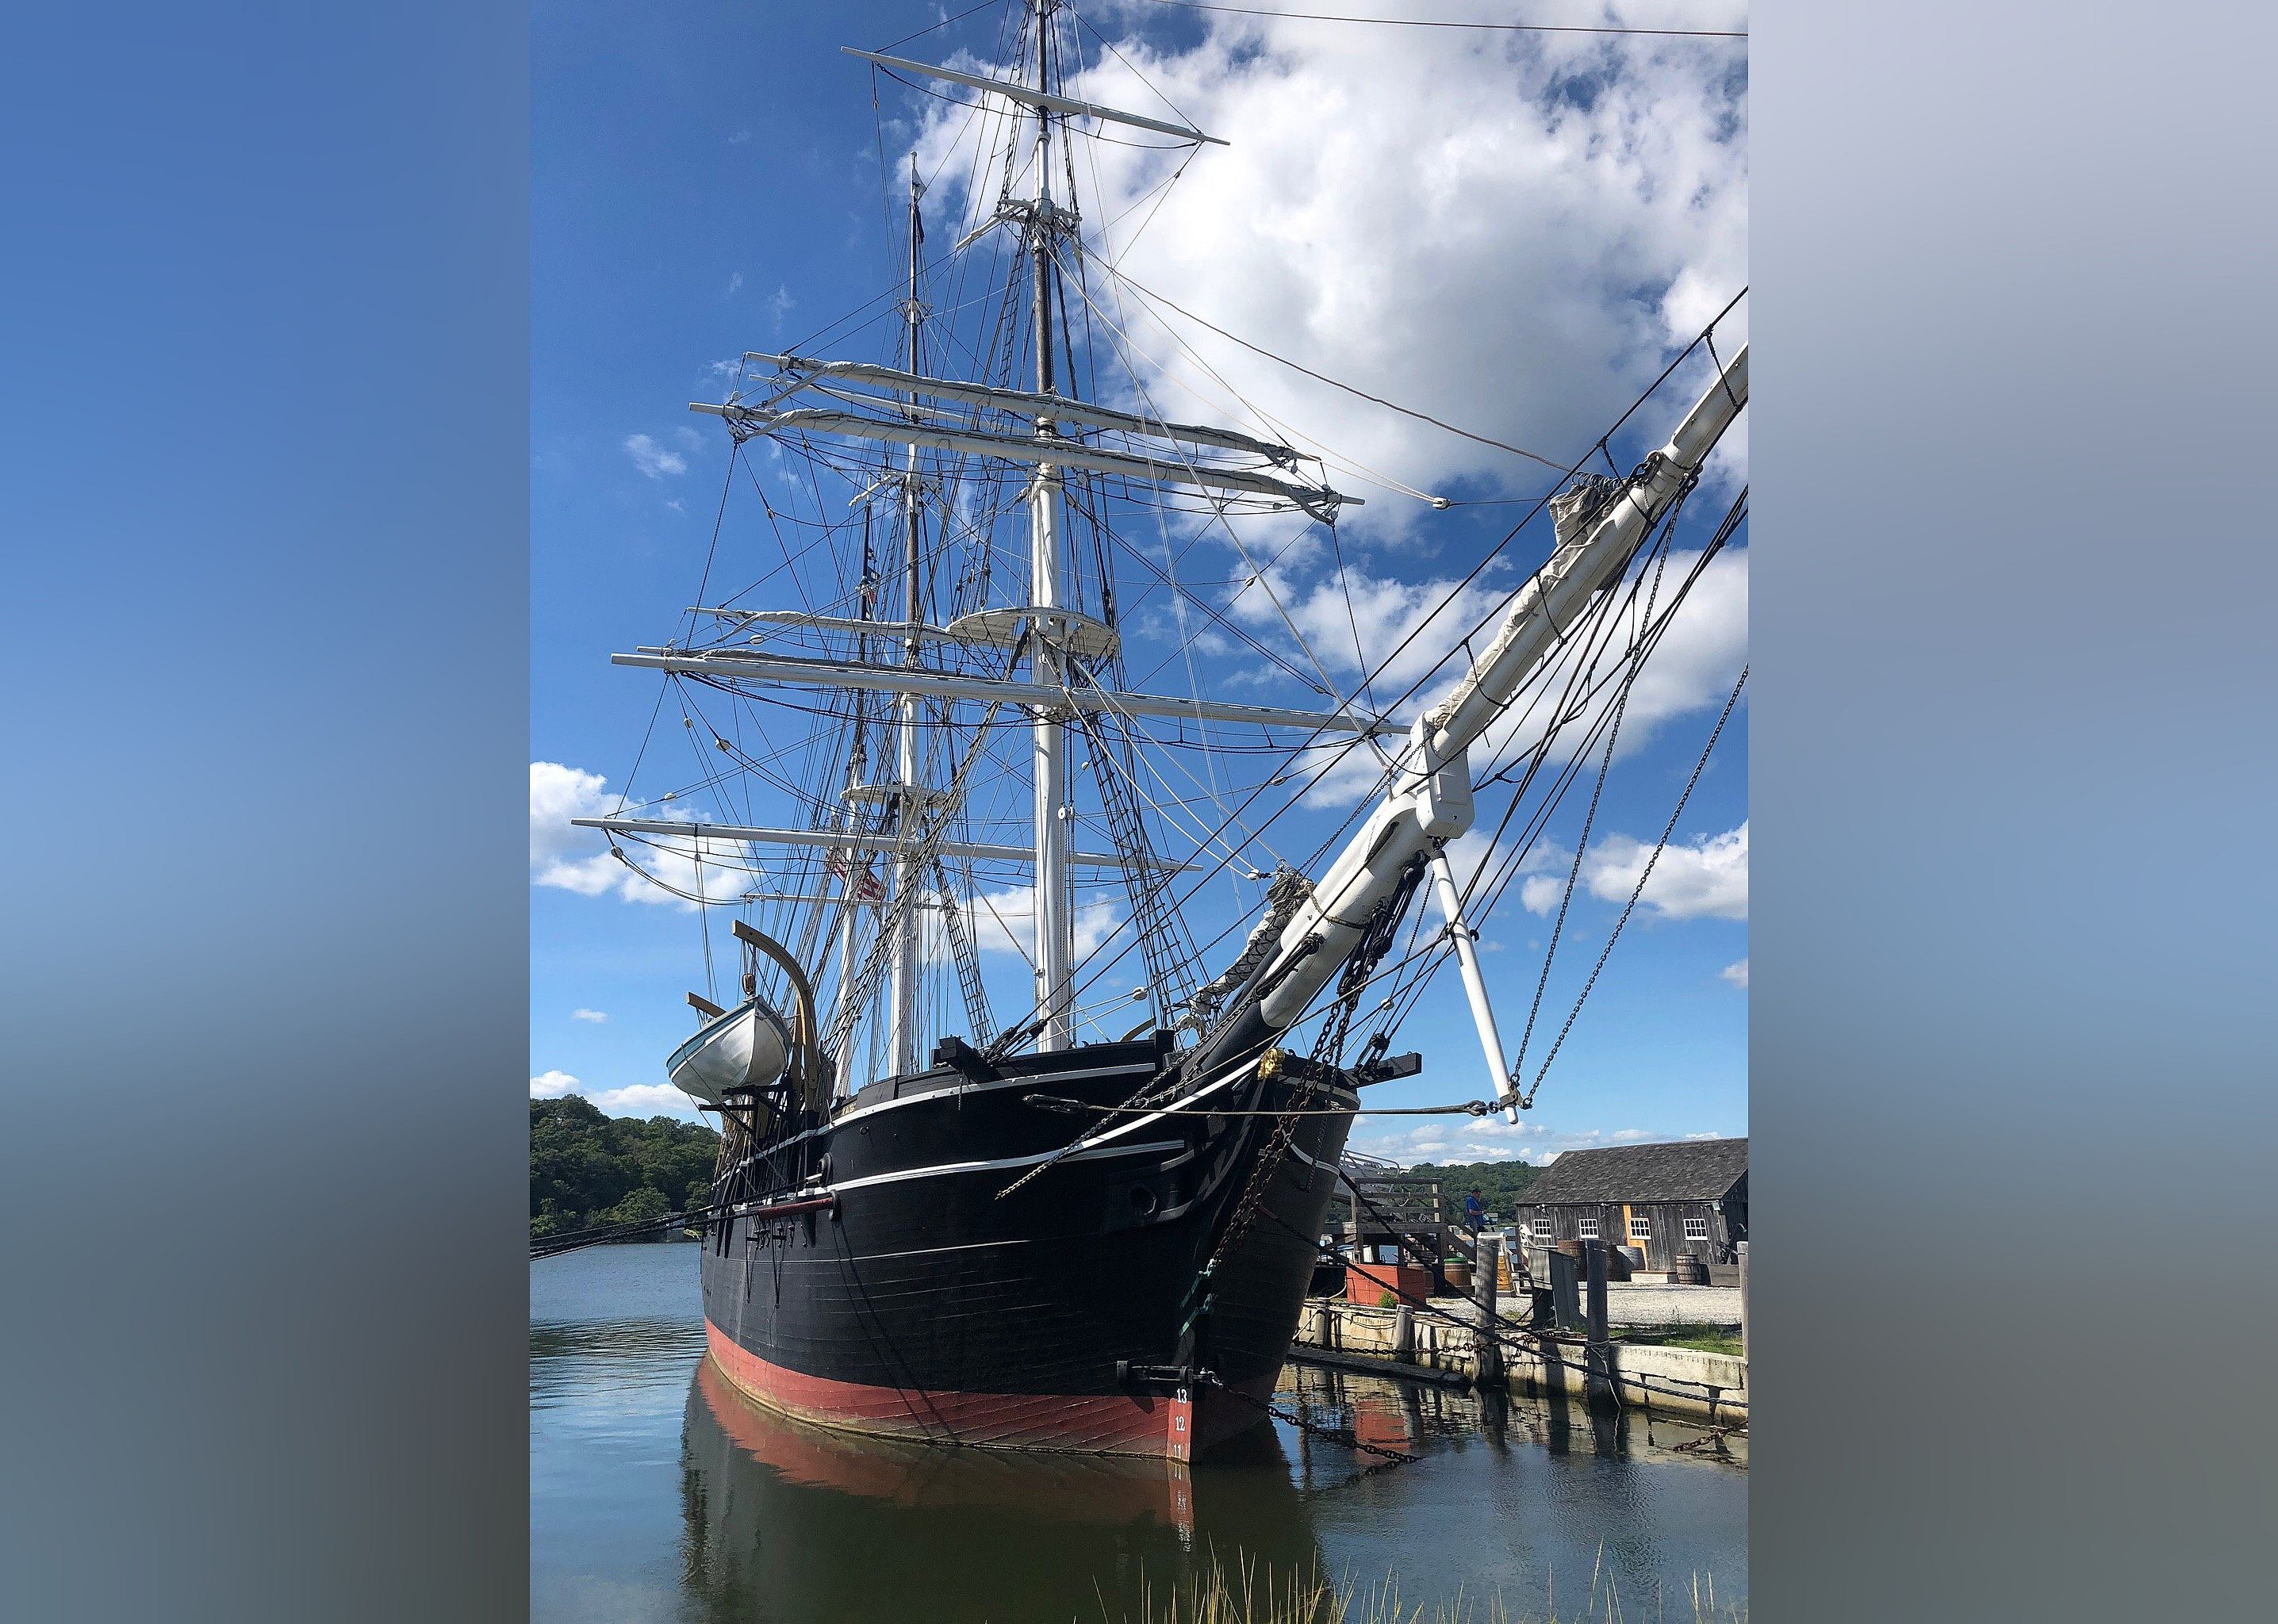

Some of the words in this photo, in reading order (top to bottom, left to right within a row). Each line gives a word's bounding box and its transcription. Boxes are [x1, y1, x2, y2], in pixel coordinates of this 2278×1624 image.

[1176, 1388, 1187, 1404] 13
[1175, 1415, 1186, 1431] 12
[1173, 1443, 1181, 1458] 11
